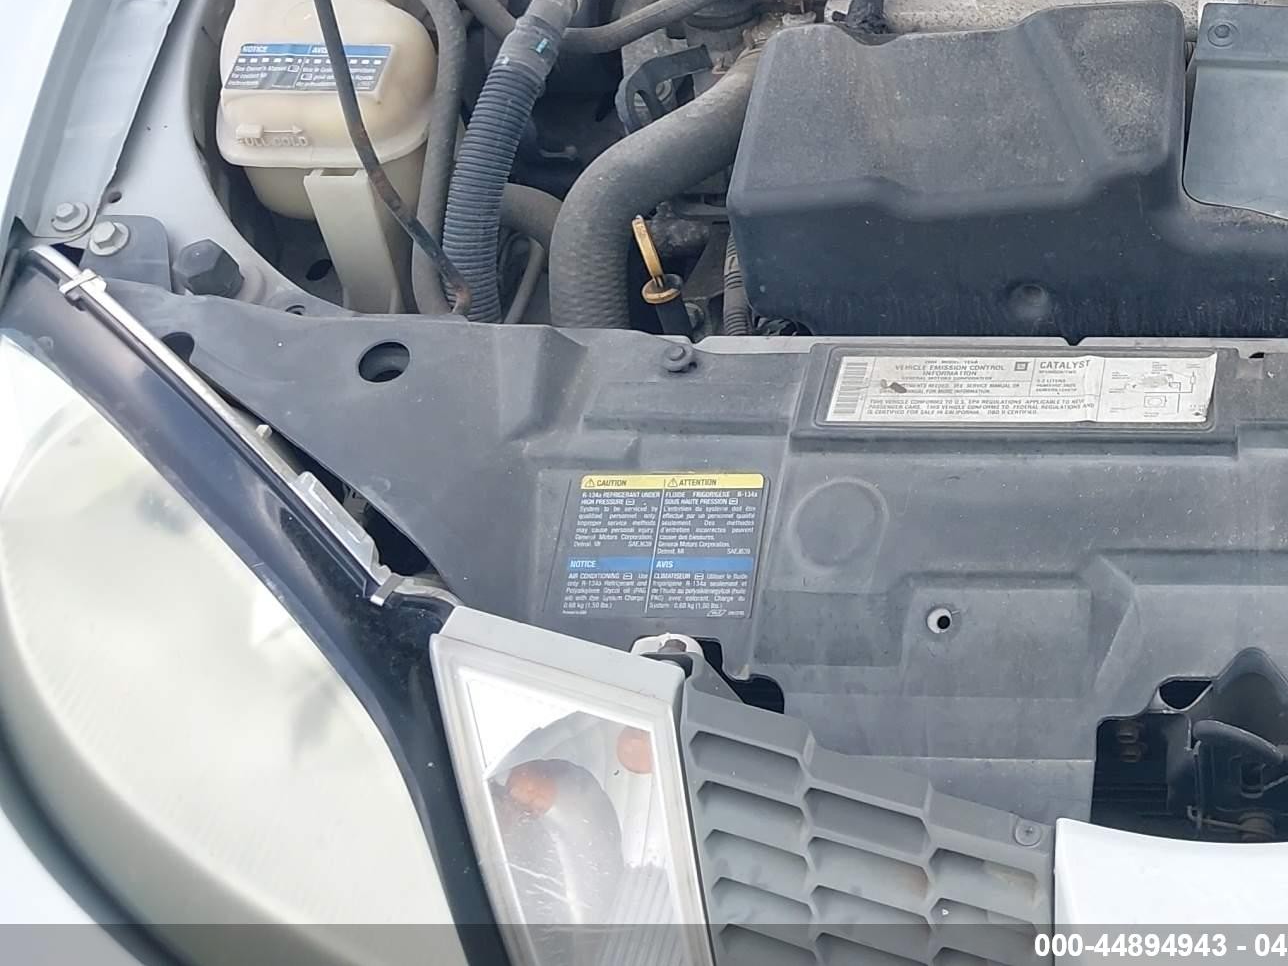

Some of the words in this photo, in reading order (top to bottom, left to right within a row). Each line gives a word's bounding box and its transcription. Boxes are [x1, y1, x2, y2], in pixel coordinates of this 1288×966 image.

[1040, 359, 1090, 369] CATALYST
[596, 479, 627, 487] CAUTION
[570, 560, 597, 568] NOTICE
[656, 560, 673, 568] AVIS
